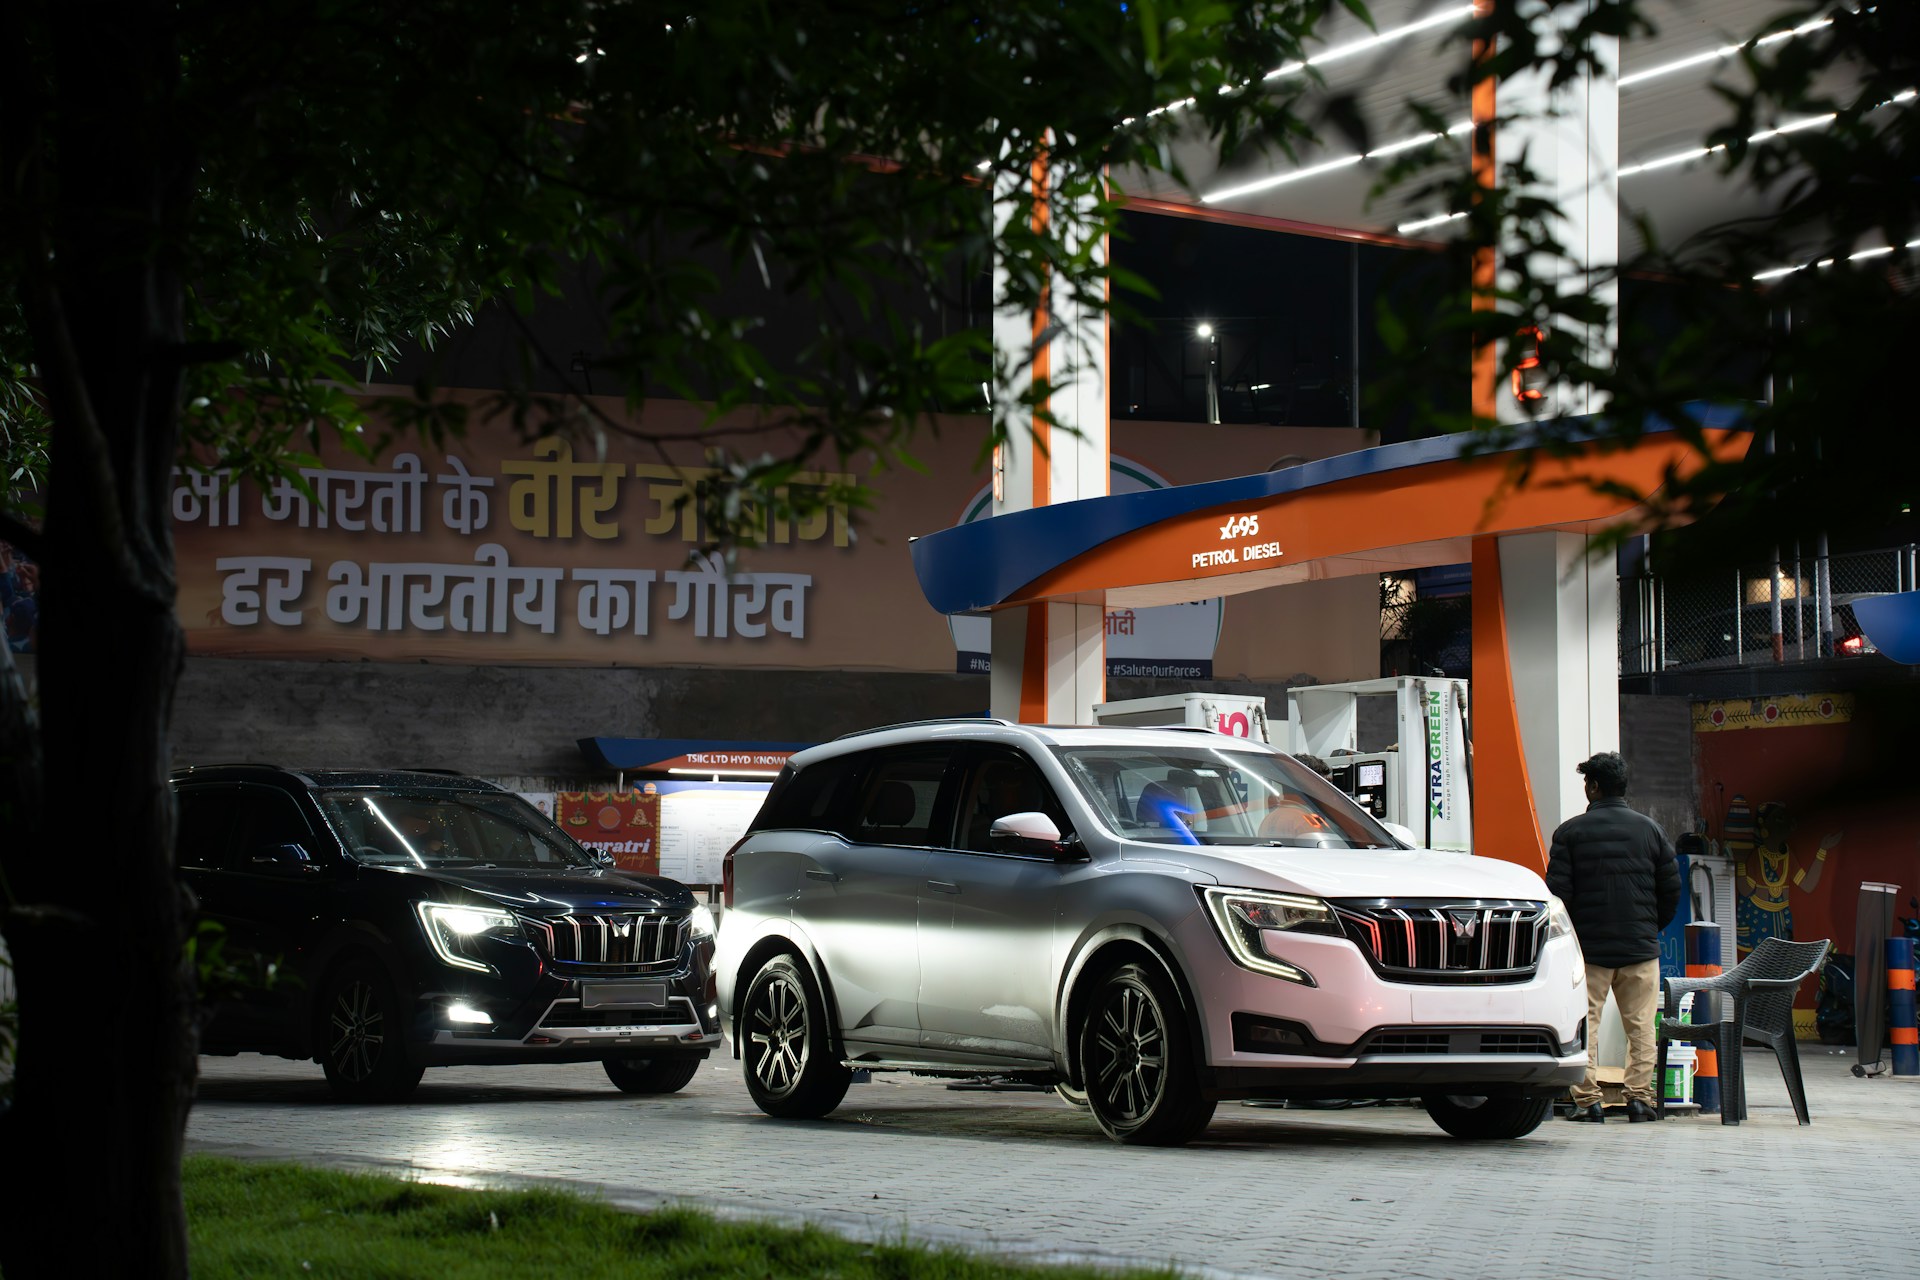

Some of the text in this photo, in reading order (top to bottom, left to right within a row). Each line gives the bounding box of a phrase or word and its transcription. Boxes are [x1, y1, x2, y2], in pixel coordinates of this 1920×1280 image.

[437, 455, 494, 534] के
[502, 435, 626, 539] वीर
[1192, 541, 1284, 568] PETROL DIESEL
[215, 543, 812, 638] हर भारतीय का गौरव
[1113, 664, 1201, 677] #SaluteOurForces
[710, 754, 729, 764] LTD
[730, 755, 751, 765] HYD
[1429, 691, 1442, 820] XTRAGREEN
